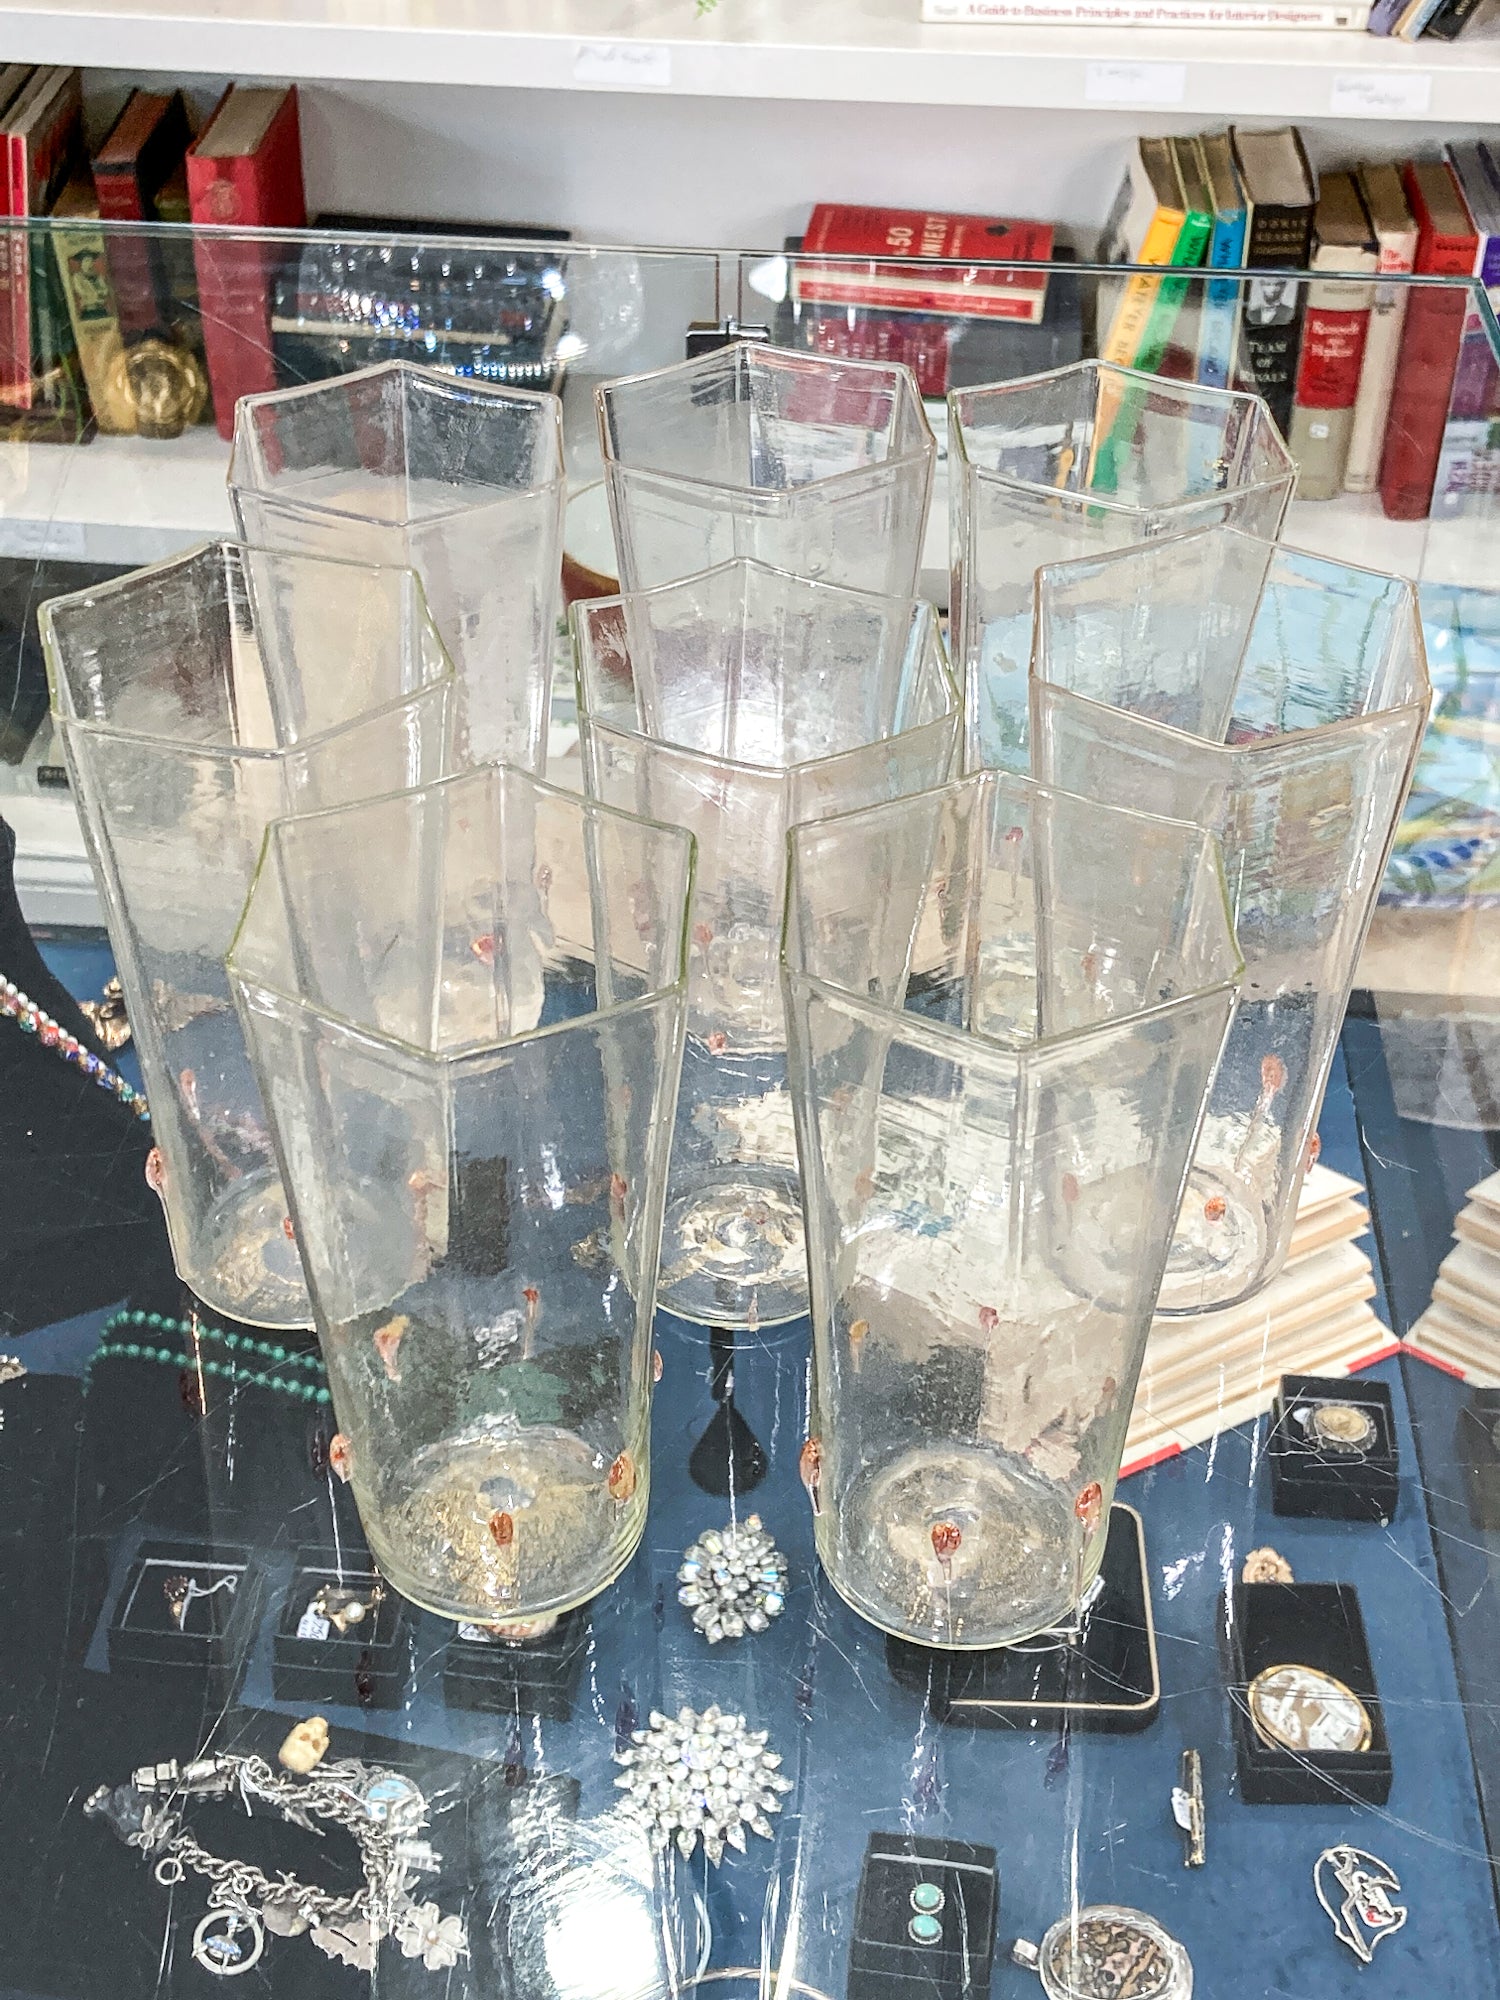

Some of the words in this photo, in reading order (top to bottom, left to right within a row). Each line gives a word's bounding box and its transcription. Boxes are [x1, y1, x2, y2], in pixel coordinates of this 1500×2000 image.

[967, 4, 975, 15] A
[977, 5, 1006, 16] Guide
[1023, 5, 1073, 17] Business
[1075, 6, 1131, 19] Principles
[1133, 8, 1154, 19] and
[1156, 8, 1205, 20] Practices
[1225, 9, 1266, 21] Interior
[886, 227, 914, 247] 50
